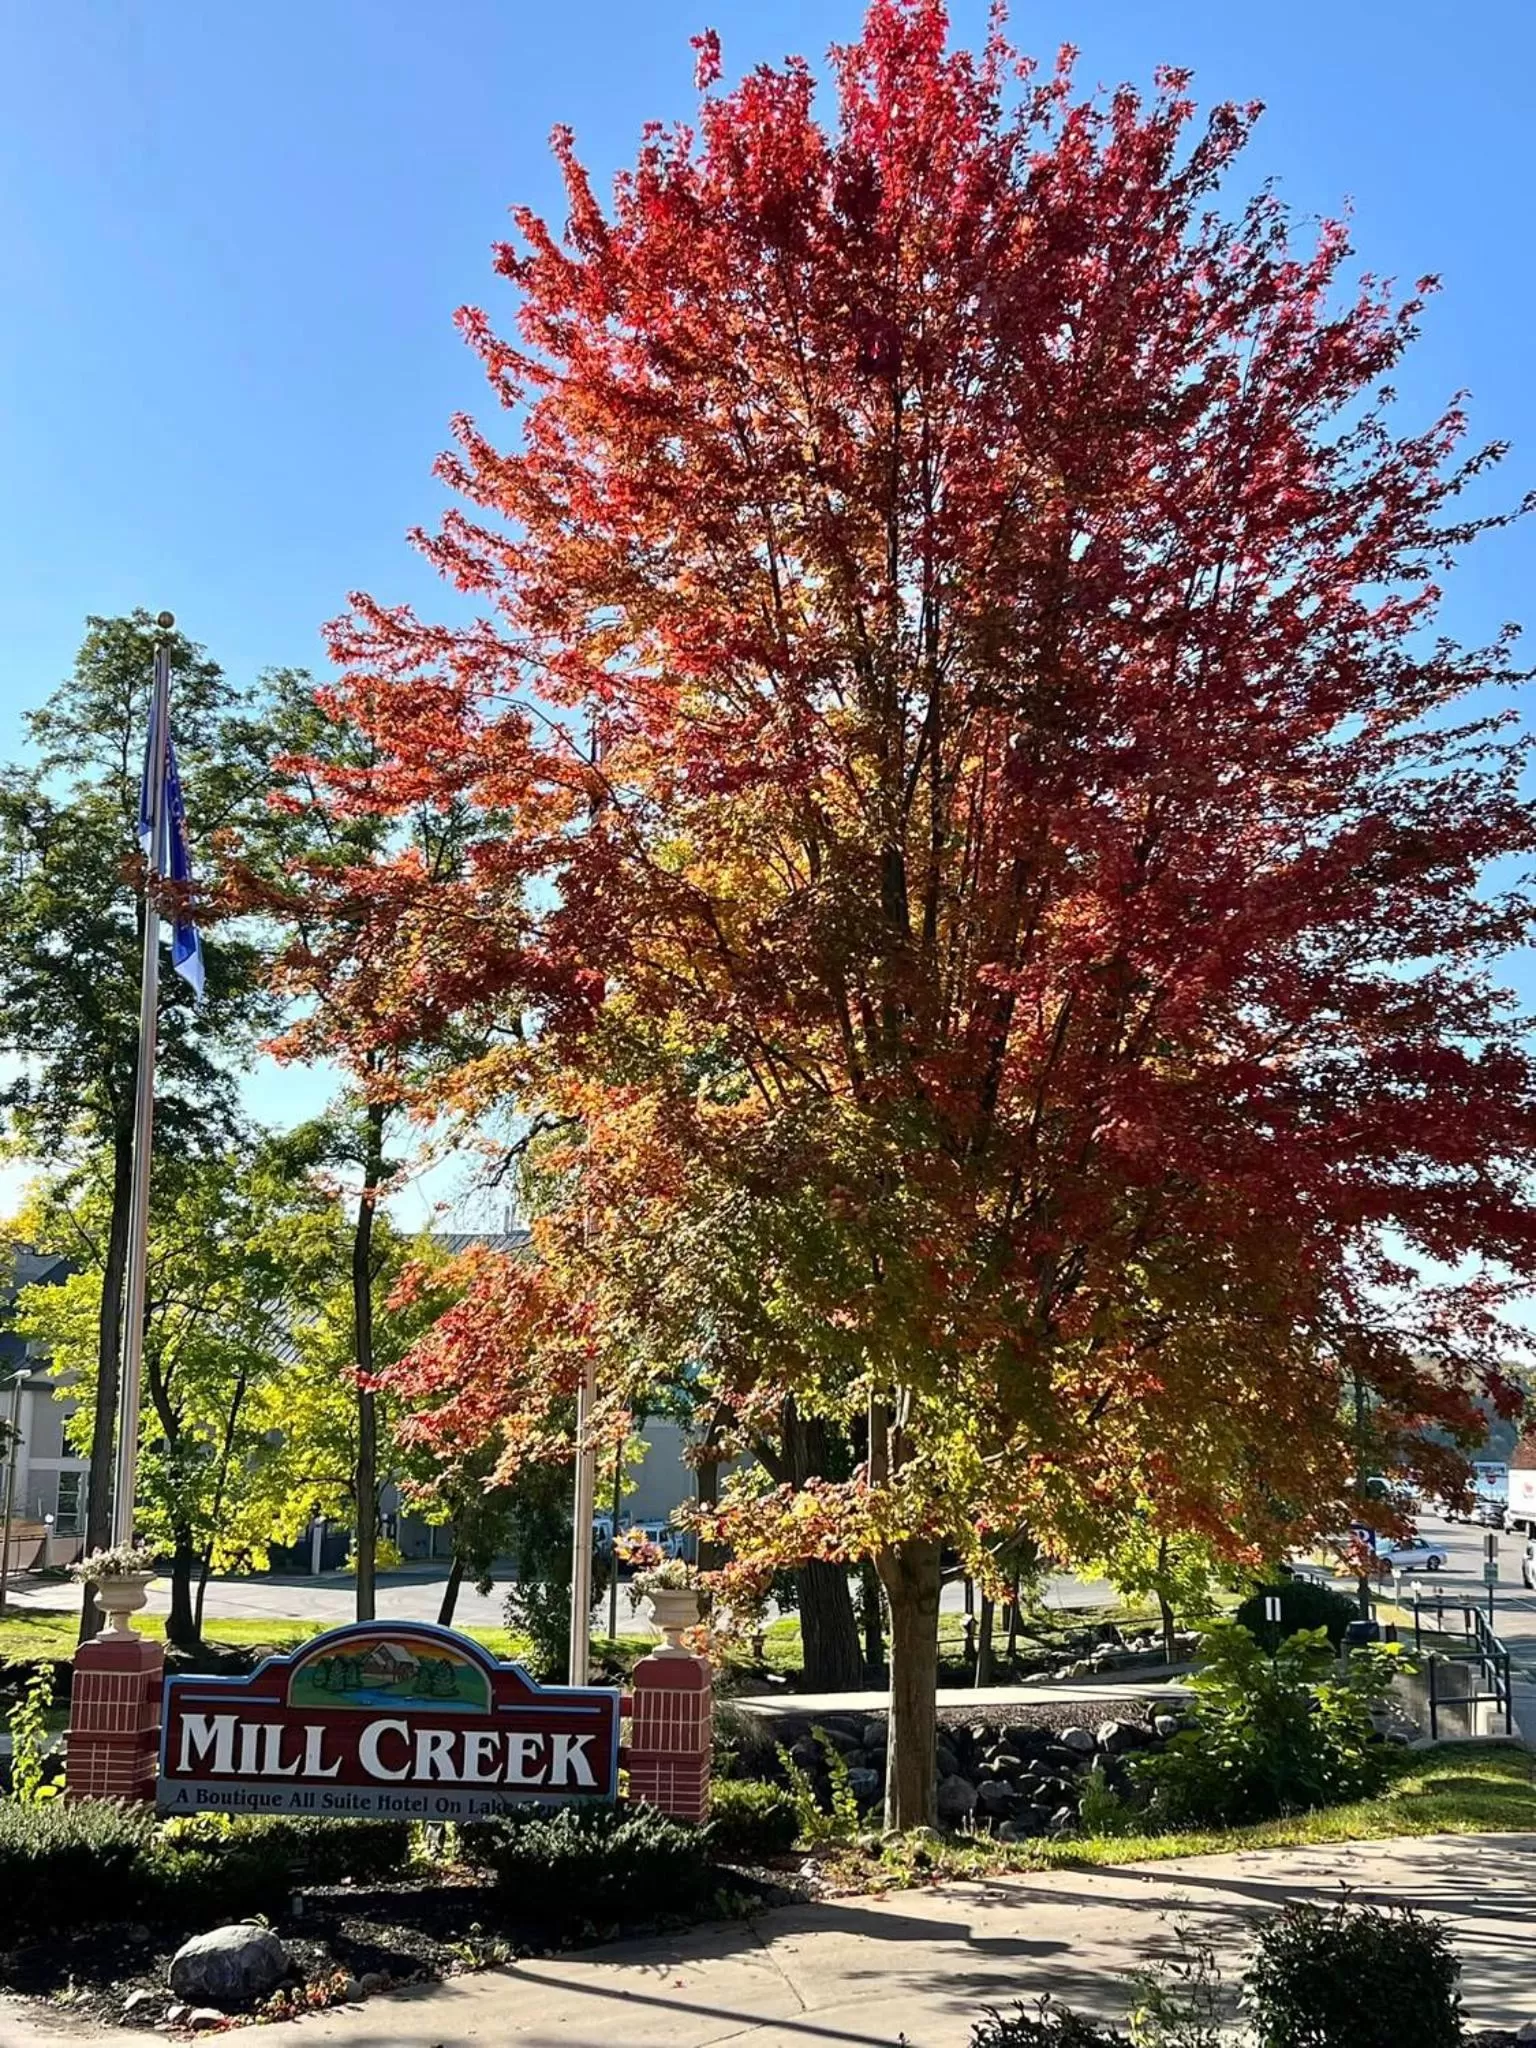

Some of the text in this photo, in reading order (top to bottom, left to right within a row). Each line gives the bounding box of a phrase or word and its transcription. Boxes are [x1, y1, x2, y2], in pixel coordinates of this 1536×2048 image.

[176, 1713, 598, 1786] MILL CREEK
[175, 1788, 189, 1804] A
[196, 1789, 282, 1811] Boutique
[288, 1792, 315, 1809] All
[321, 1793, 371, 1810] Suite
[377, 1795, 428, 1813] Hotel
[435, 1798, 461, 1814] On
[468, 1799, 514, 1817] Lake
